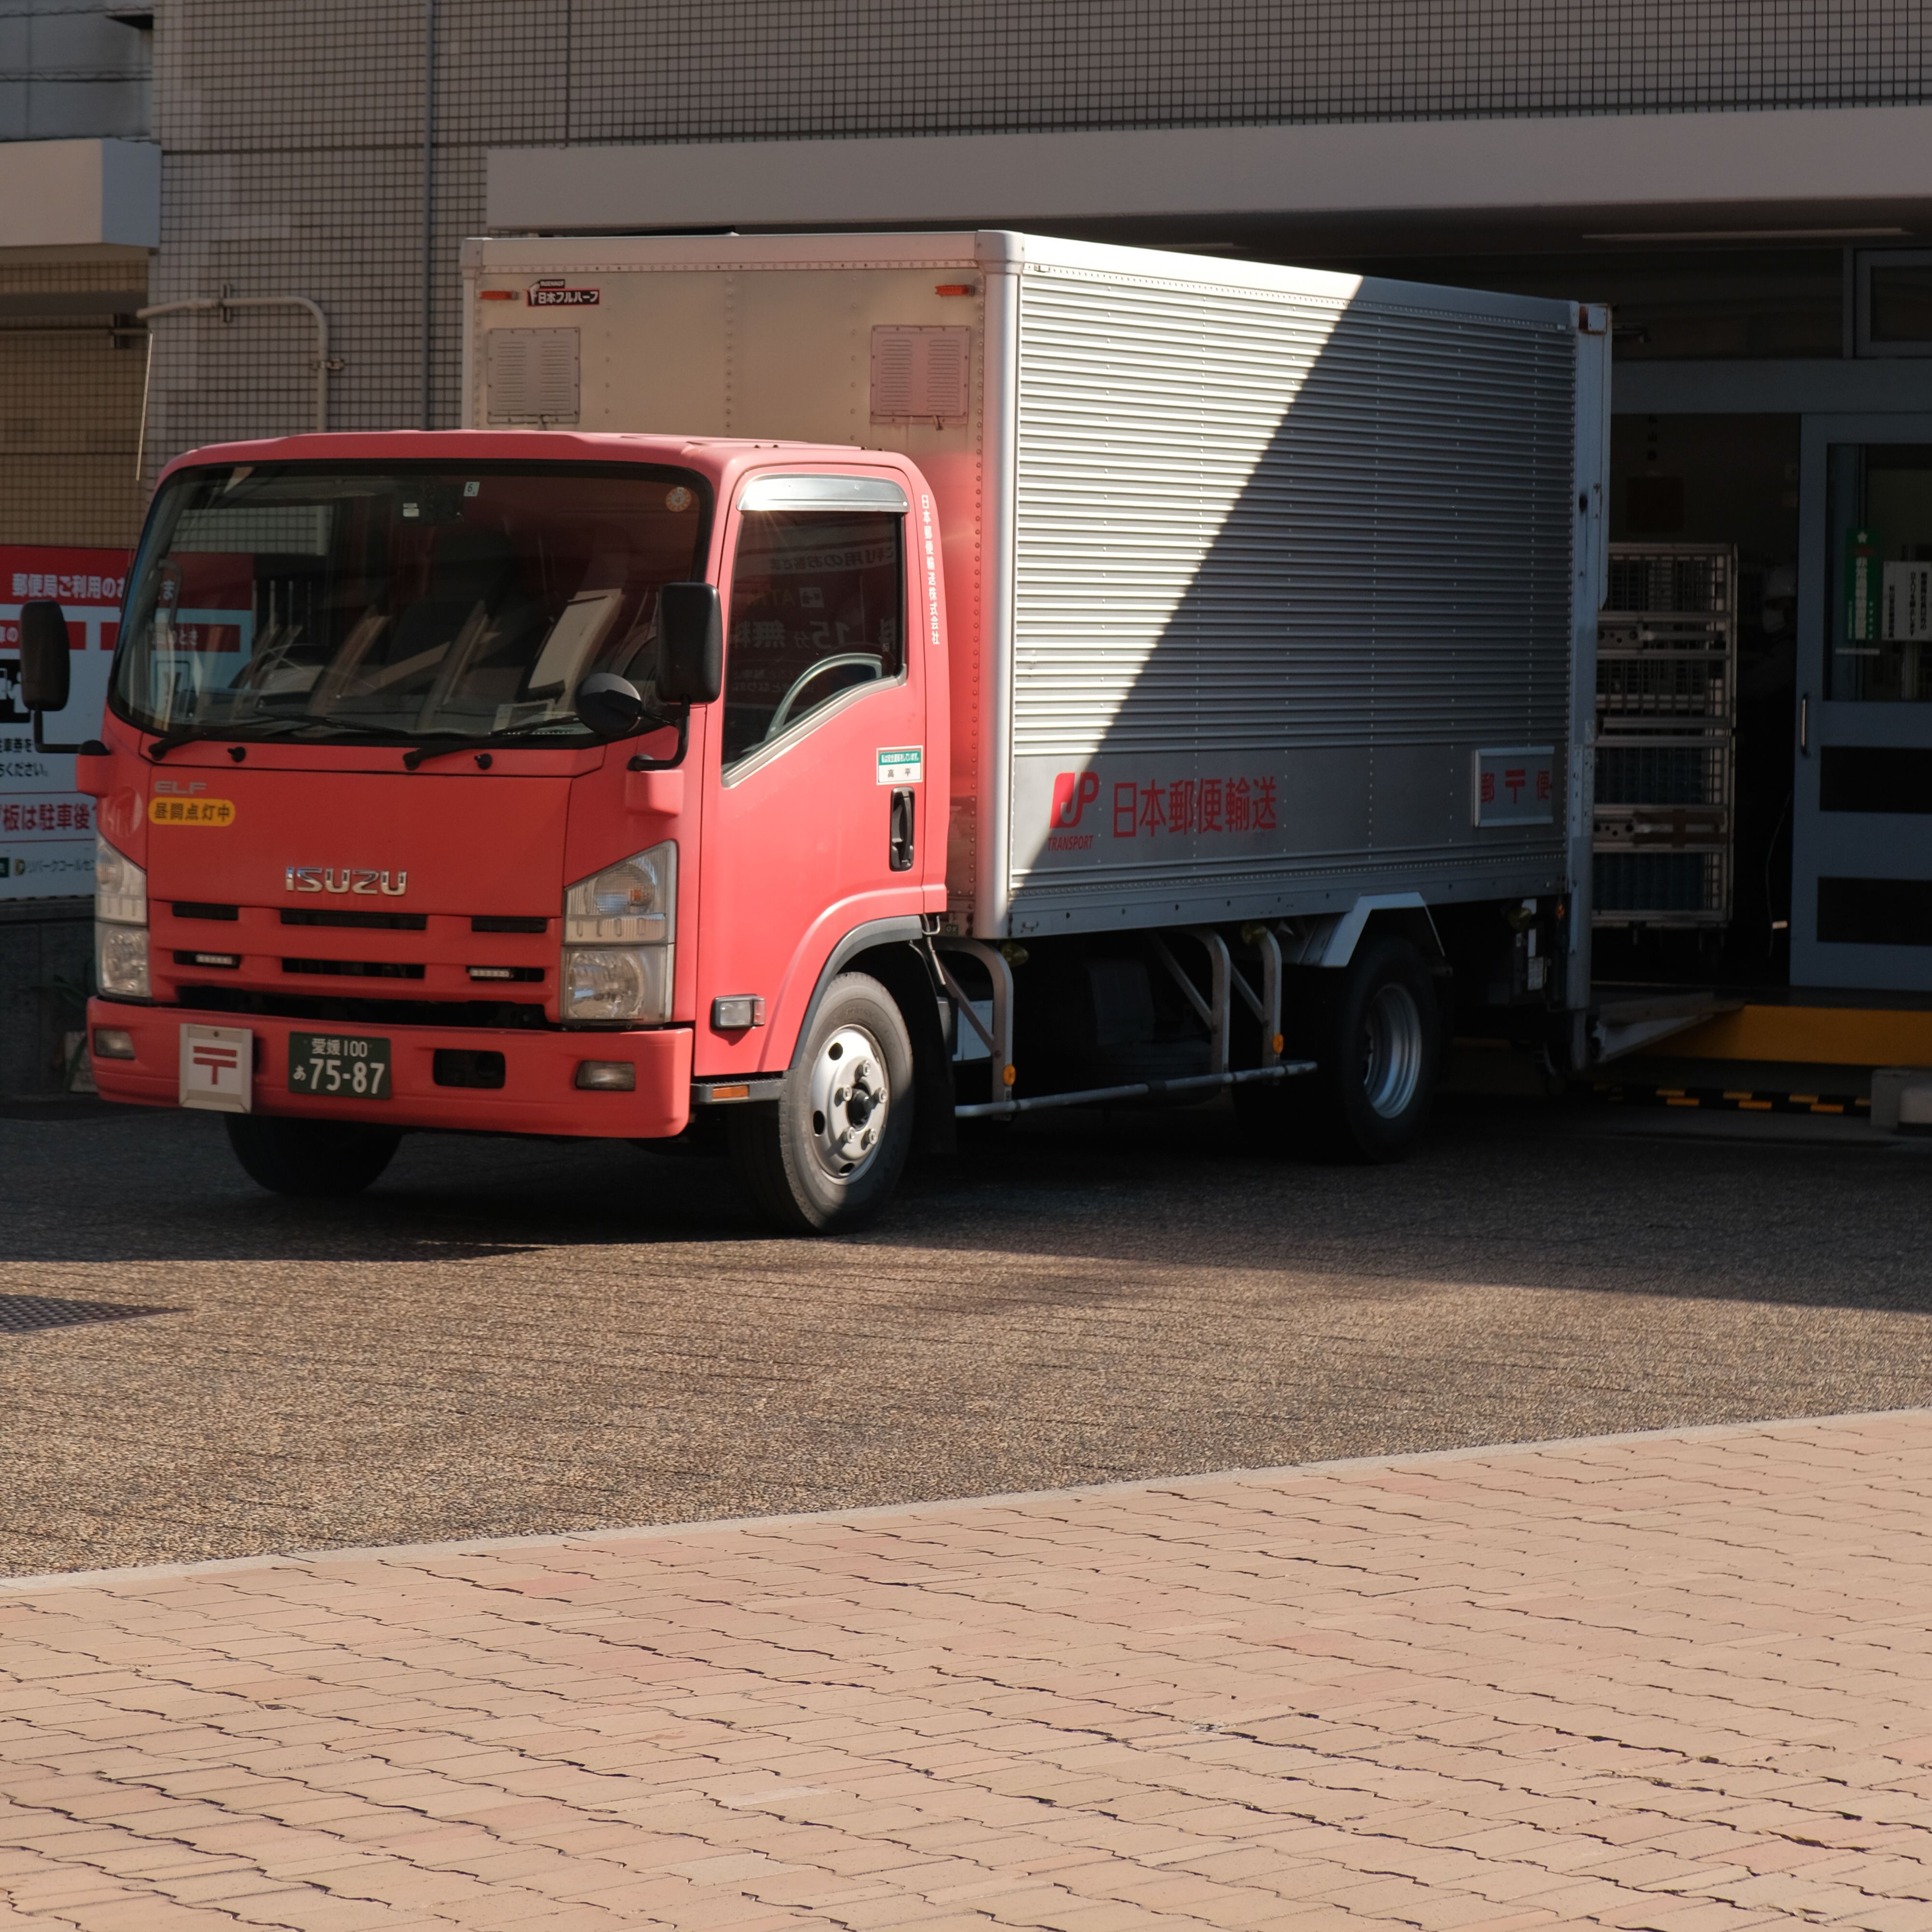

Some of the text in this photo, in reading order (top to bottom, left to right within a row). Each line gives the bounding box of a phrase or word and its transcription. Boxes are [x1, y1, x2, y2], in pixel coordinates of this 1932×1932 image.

[538, 291, 598, 304] 日本フルハーフ
[921, 494, 940, 645] 日本郵便輸送株式会社
[155, 780, 207, 795] ELF
[1050, 771, 1100, 829] JP
[155, 801, 230, 822] 昼間点灯中
[1113, 775, 1277, 838] 日本郵便輸送
[1048, 835, 1094, 852] TRANSPORT
[284, 866, 408, 896] ISUZU
[312, 1037, 368, 1058] 愛媛 100
[293, 1058, 385, 1094] あ 75-87
